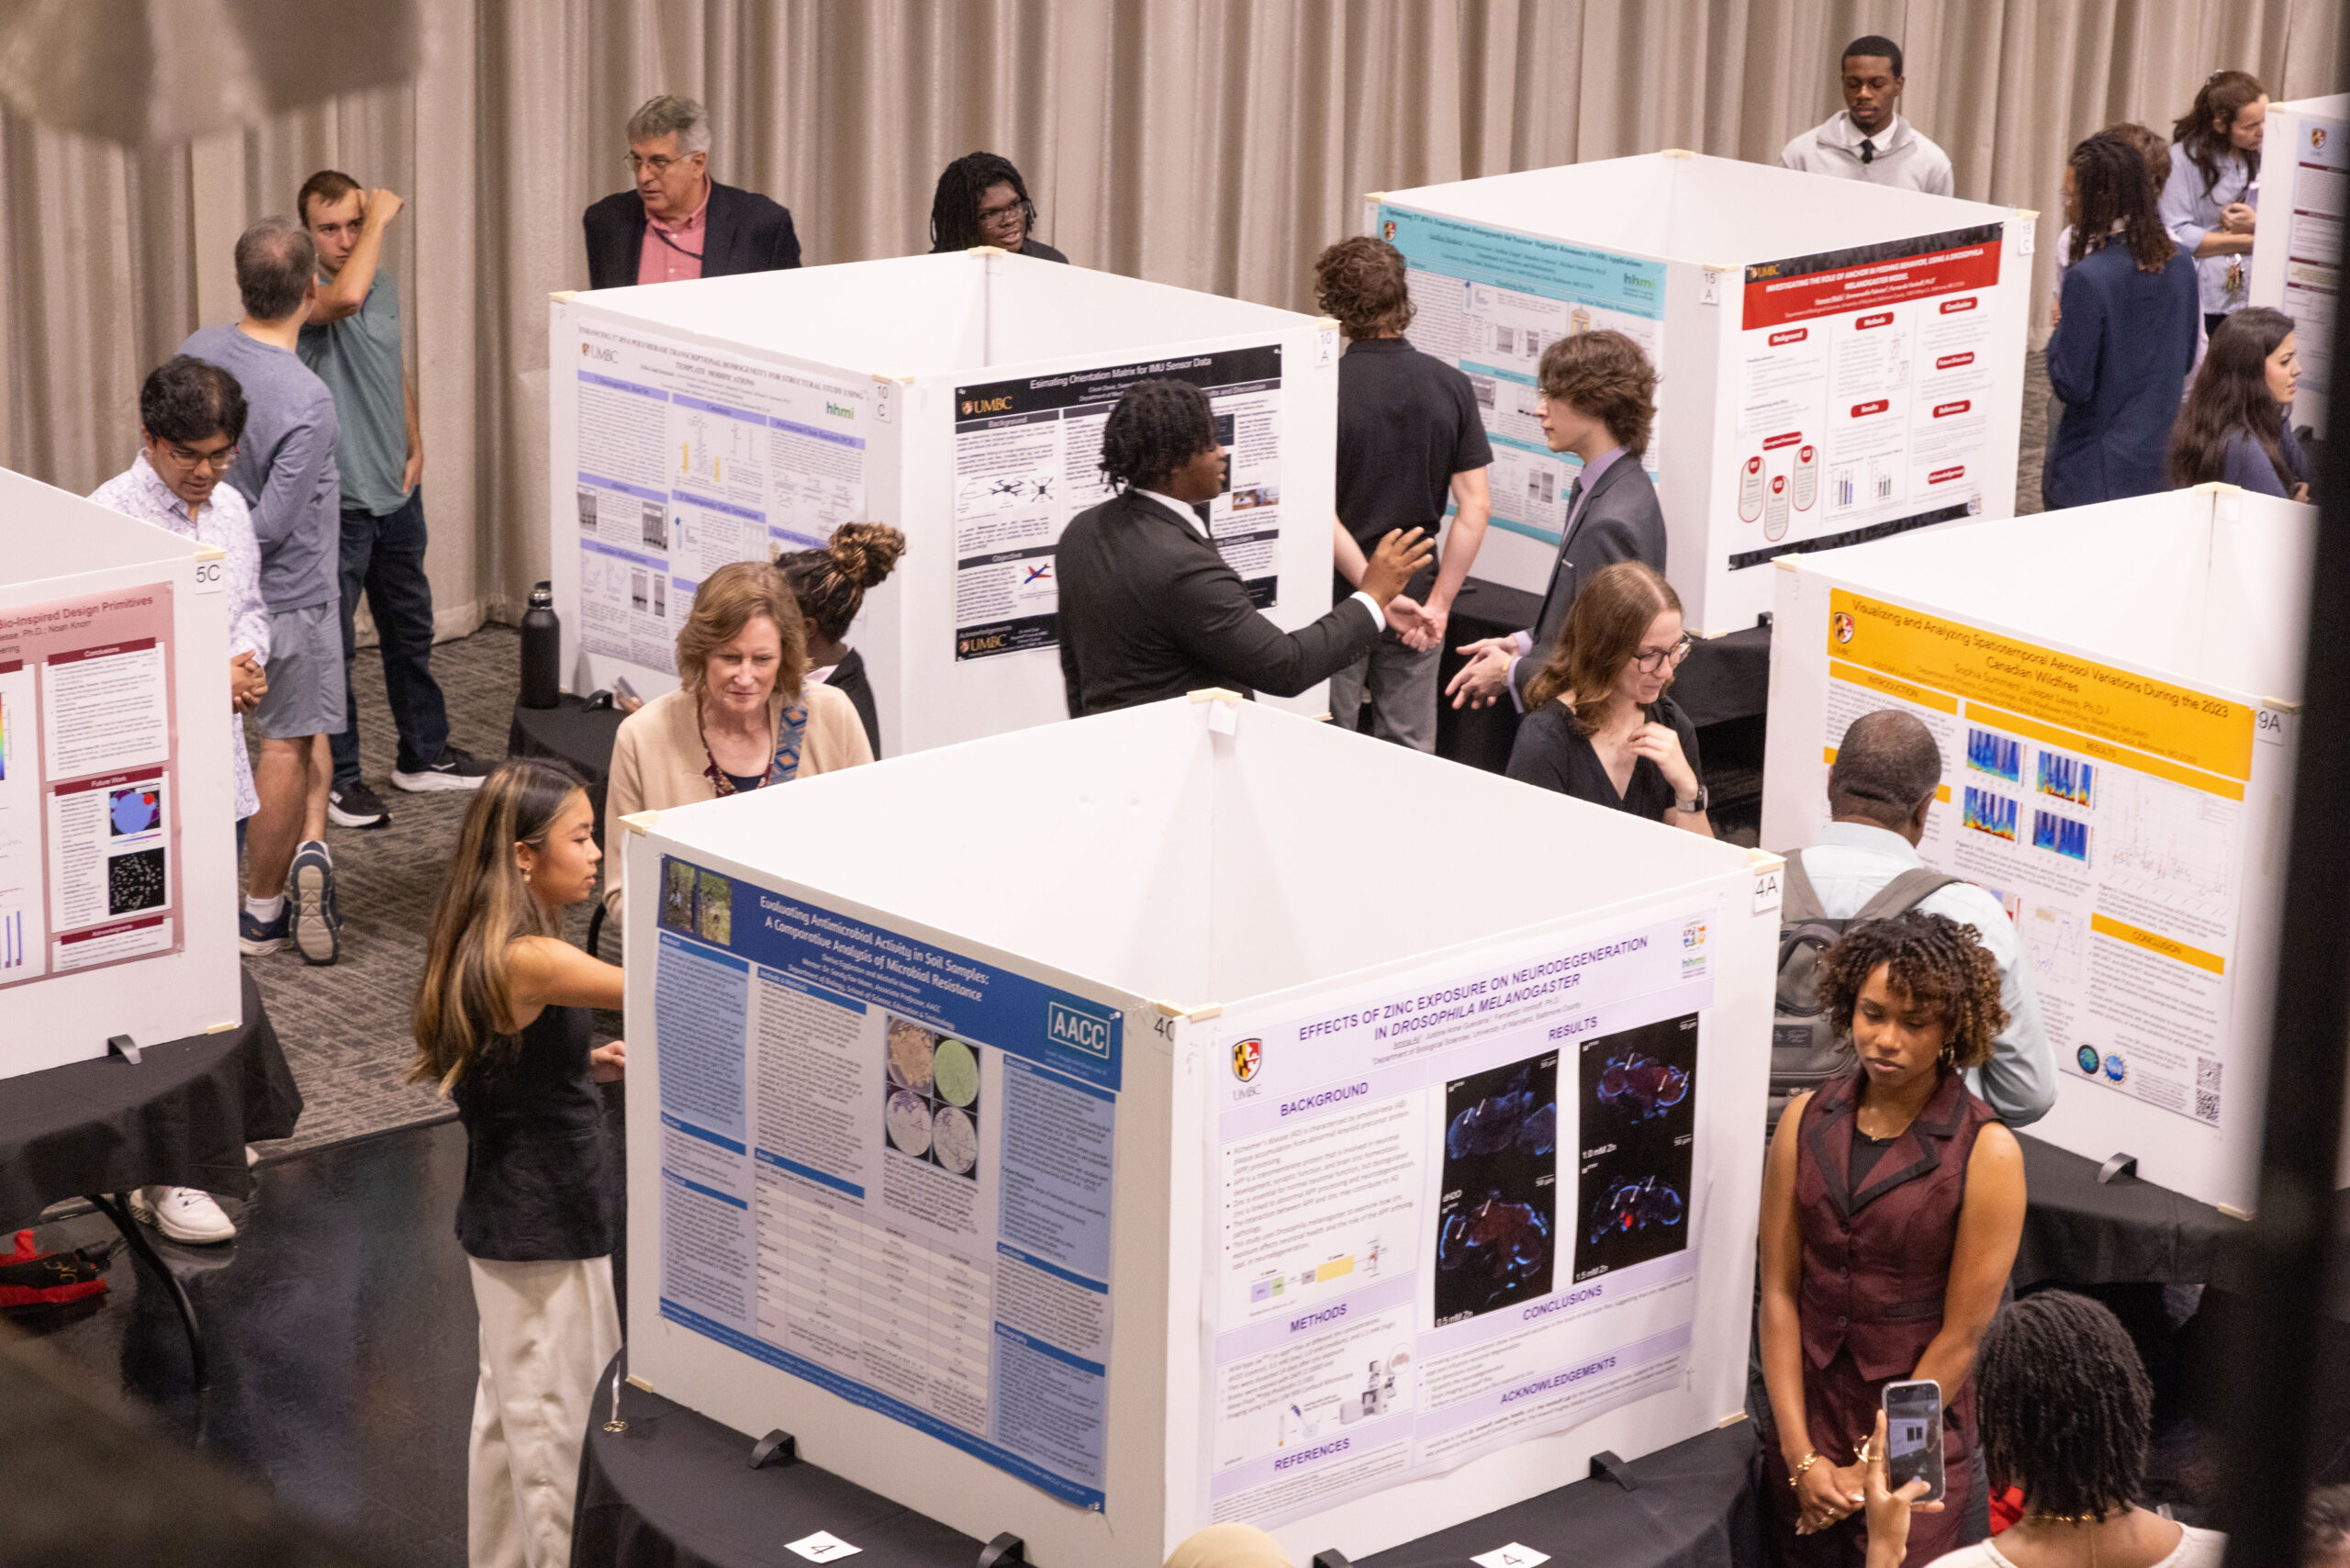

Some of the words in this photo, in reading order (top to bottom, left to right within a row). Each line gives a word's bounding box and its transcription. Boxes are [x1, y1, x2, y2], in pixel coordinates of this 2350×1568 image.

[1623, 274, 1655, 288] hhmi
[1705, 273, 1716, 285] 15
[1705, 289, 1713, 300] A
[1320, 334, 1332, 345] 10
[591, 344, 619, 364] UMBC
[1321, 352, 1329, 362] A
[1069, 370, 1112, 385] Orientation
[1136, 364, 1147, 375] for
[1166, 359, 1192, 371] Sensor
[1193, 356, 1213, 368] Data
[878, 386, 889, 399] 10
[826, 401, 855, 420] hhmi
[878, 404, 886, 417] C
[973, 396, 1013, 413] UMBC
[988, 416, 1027, 429] Background
[196, 564, 221, 583] 5C
[62, 605, 99, 620] Design
[102, 596, 153, 611] Primitives
[970, 633, 1008, 651] UMBC
[1852, 599, 1901, 626] Visualizing
[1903, 614, 1921, 629] and
[1923, 620, 1969, 646] Analyzing
[1972, 633, 2047, 668] Spatiotemporal
[2049, 655, 2087, 678] Aerosol
[2091, 667, 2141, 693] Variations
[2143, 682, 2179, 707] During
[2181, 694, 2199, 709] the
[2201, 699, 2228, 718] 2023
[1986, 655, 2031, 679] Canadian
[2035, 667, 2079, 693] Wildfires
[2258, 711, 2281, 733] 9A
[1755, 876, 1778, 898] 4A
[760, 894, 810, 924] Evaluating
[811, 913, 873, 945] Antimicrobial
[874, 935, 912, 958] Activity
[913, 948, 923, 962] in
[925, 953, 944, 969] Soil
[945, 959, 990, 985] Samples:
[765, 916, 773, 929] A
[774, 920, 832, 949] Comparative
[833, 940, 873, 963] Analysis
[874, 955, 885, 968] of
[886, 958, 930, 983] Microbial
[932, 975, 982, 1001] Resistance
[1299, 1012, 1358, 1042] EFFECTS
[1362, 1007, 1380, 1025] OF
[1383, 998, 1413, 1019] ZINC
[1417, 979, 1486, 1011] EXPOSURE
[1490, 973, 1507, 991] ON
[1511, 935, 1647, 985] NEURODEGENERATION
[1374, 1025, 1387, 1040] IN
[1392, 1001, 1474, 1036] DROSOPHILA
[1478, 972, 1581, 1013] MELANOGASTER
[1054, 1012, 1104, 1050] AACC
[1154, 1017, 1173, 1041] 4C
[1548, 1016, 1597, 1041] RESULTS
[1233, 1084, 1262, 1101] UMBC
[1280, 1081, 1369, 1116] BACKGROUND
[1523, 1285, 1603, 1320] CONCLUSIONS
[1290, 1303, 1348, 1333] METHODS
[1501, 1356, 1617, 1405] ACKNOWLEDGEMENTS
[1274, 1438, 1350, 1472] REFERENCES
[811, 1545, 836, 1555] 4
[1503, 1554, 1525, 1565] 4
